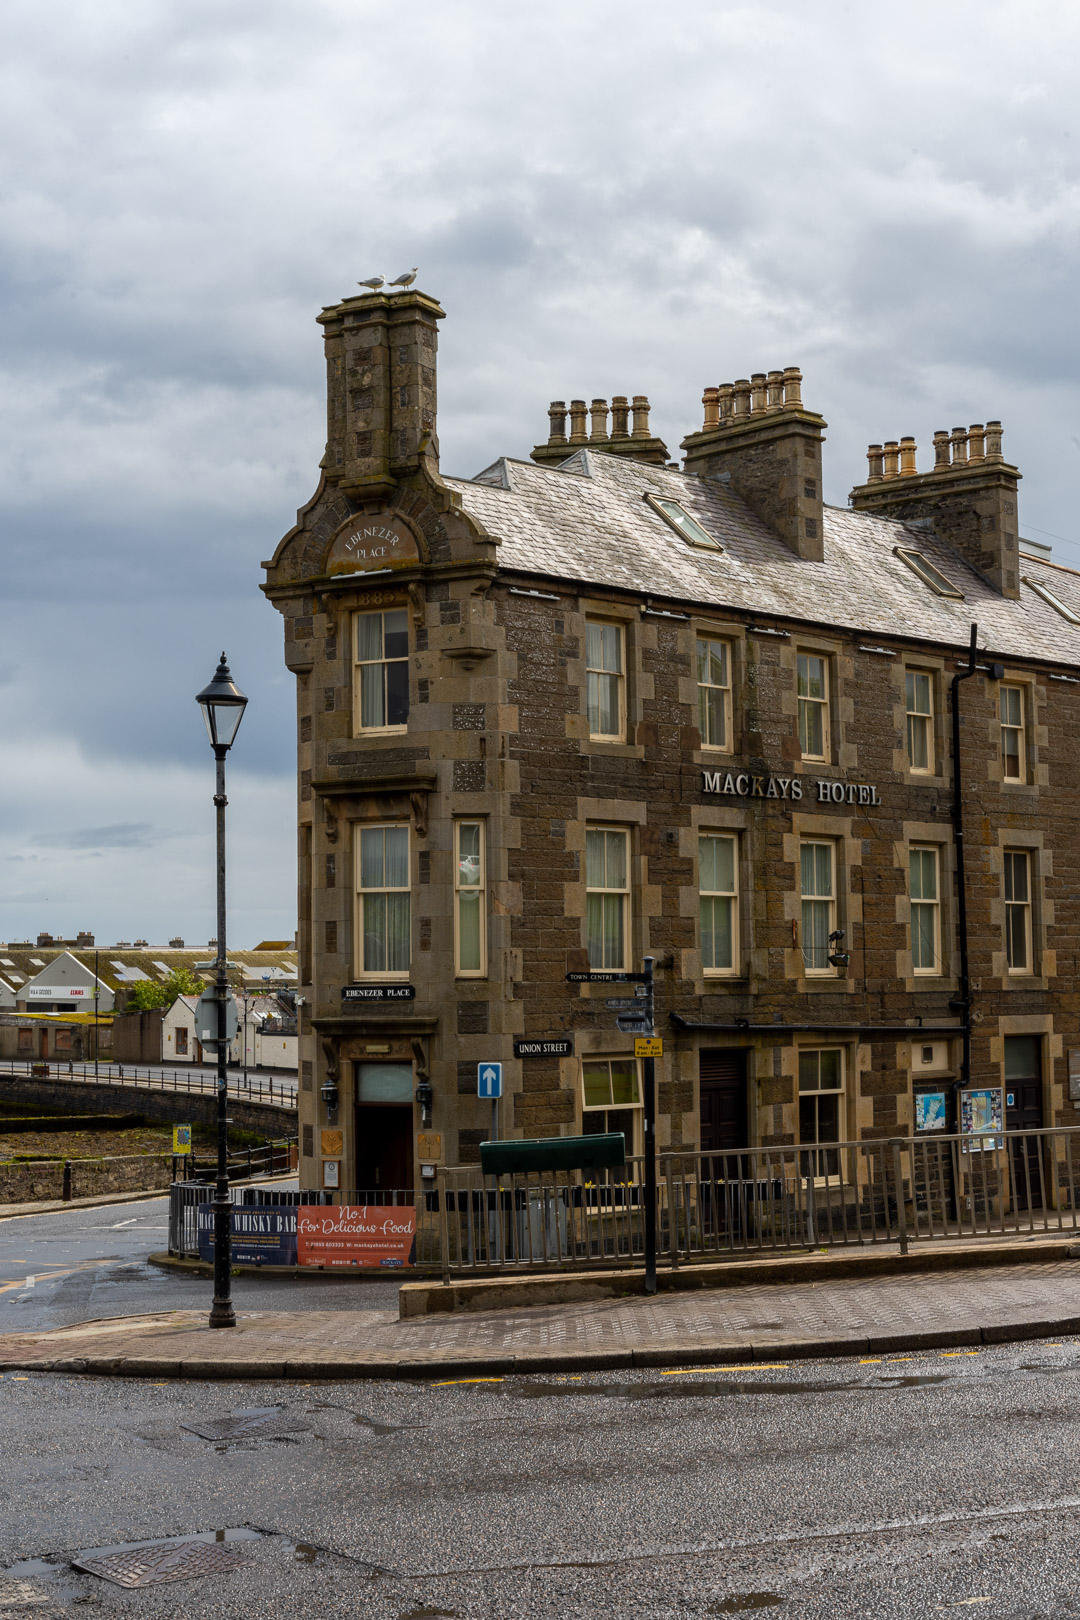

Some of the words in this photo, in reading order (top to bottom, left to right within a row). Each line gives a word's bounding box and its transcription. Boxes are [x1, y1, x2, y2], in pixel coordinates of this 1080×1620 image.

[345, 526, 399, 550] EBENEZER
[357, 546, 387, 558] PLACE
[702, 771, 803, 800] MACKAYS
[817, 781, 881, 806] HOTEL
[346, 989, 383, 997] EBENEZER
[387, 989, 410, 997] PLACE
[519, 1044, 542, 1053] UNION
[543, 1043, 568, 1052] STREET
[339, 1206, 367, 1220] No.1
[234, 1215, 272, 1232] WHISKY
[276, 1216, 297, 1232] BAR
[322, 1219, 377, 1234] Delicious
